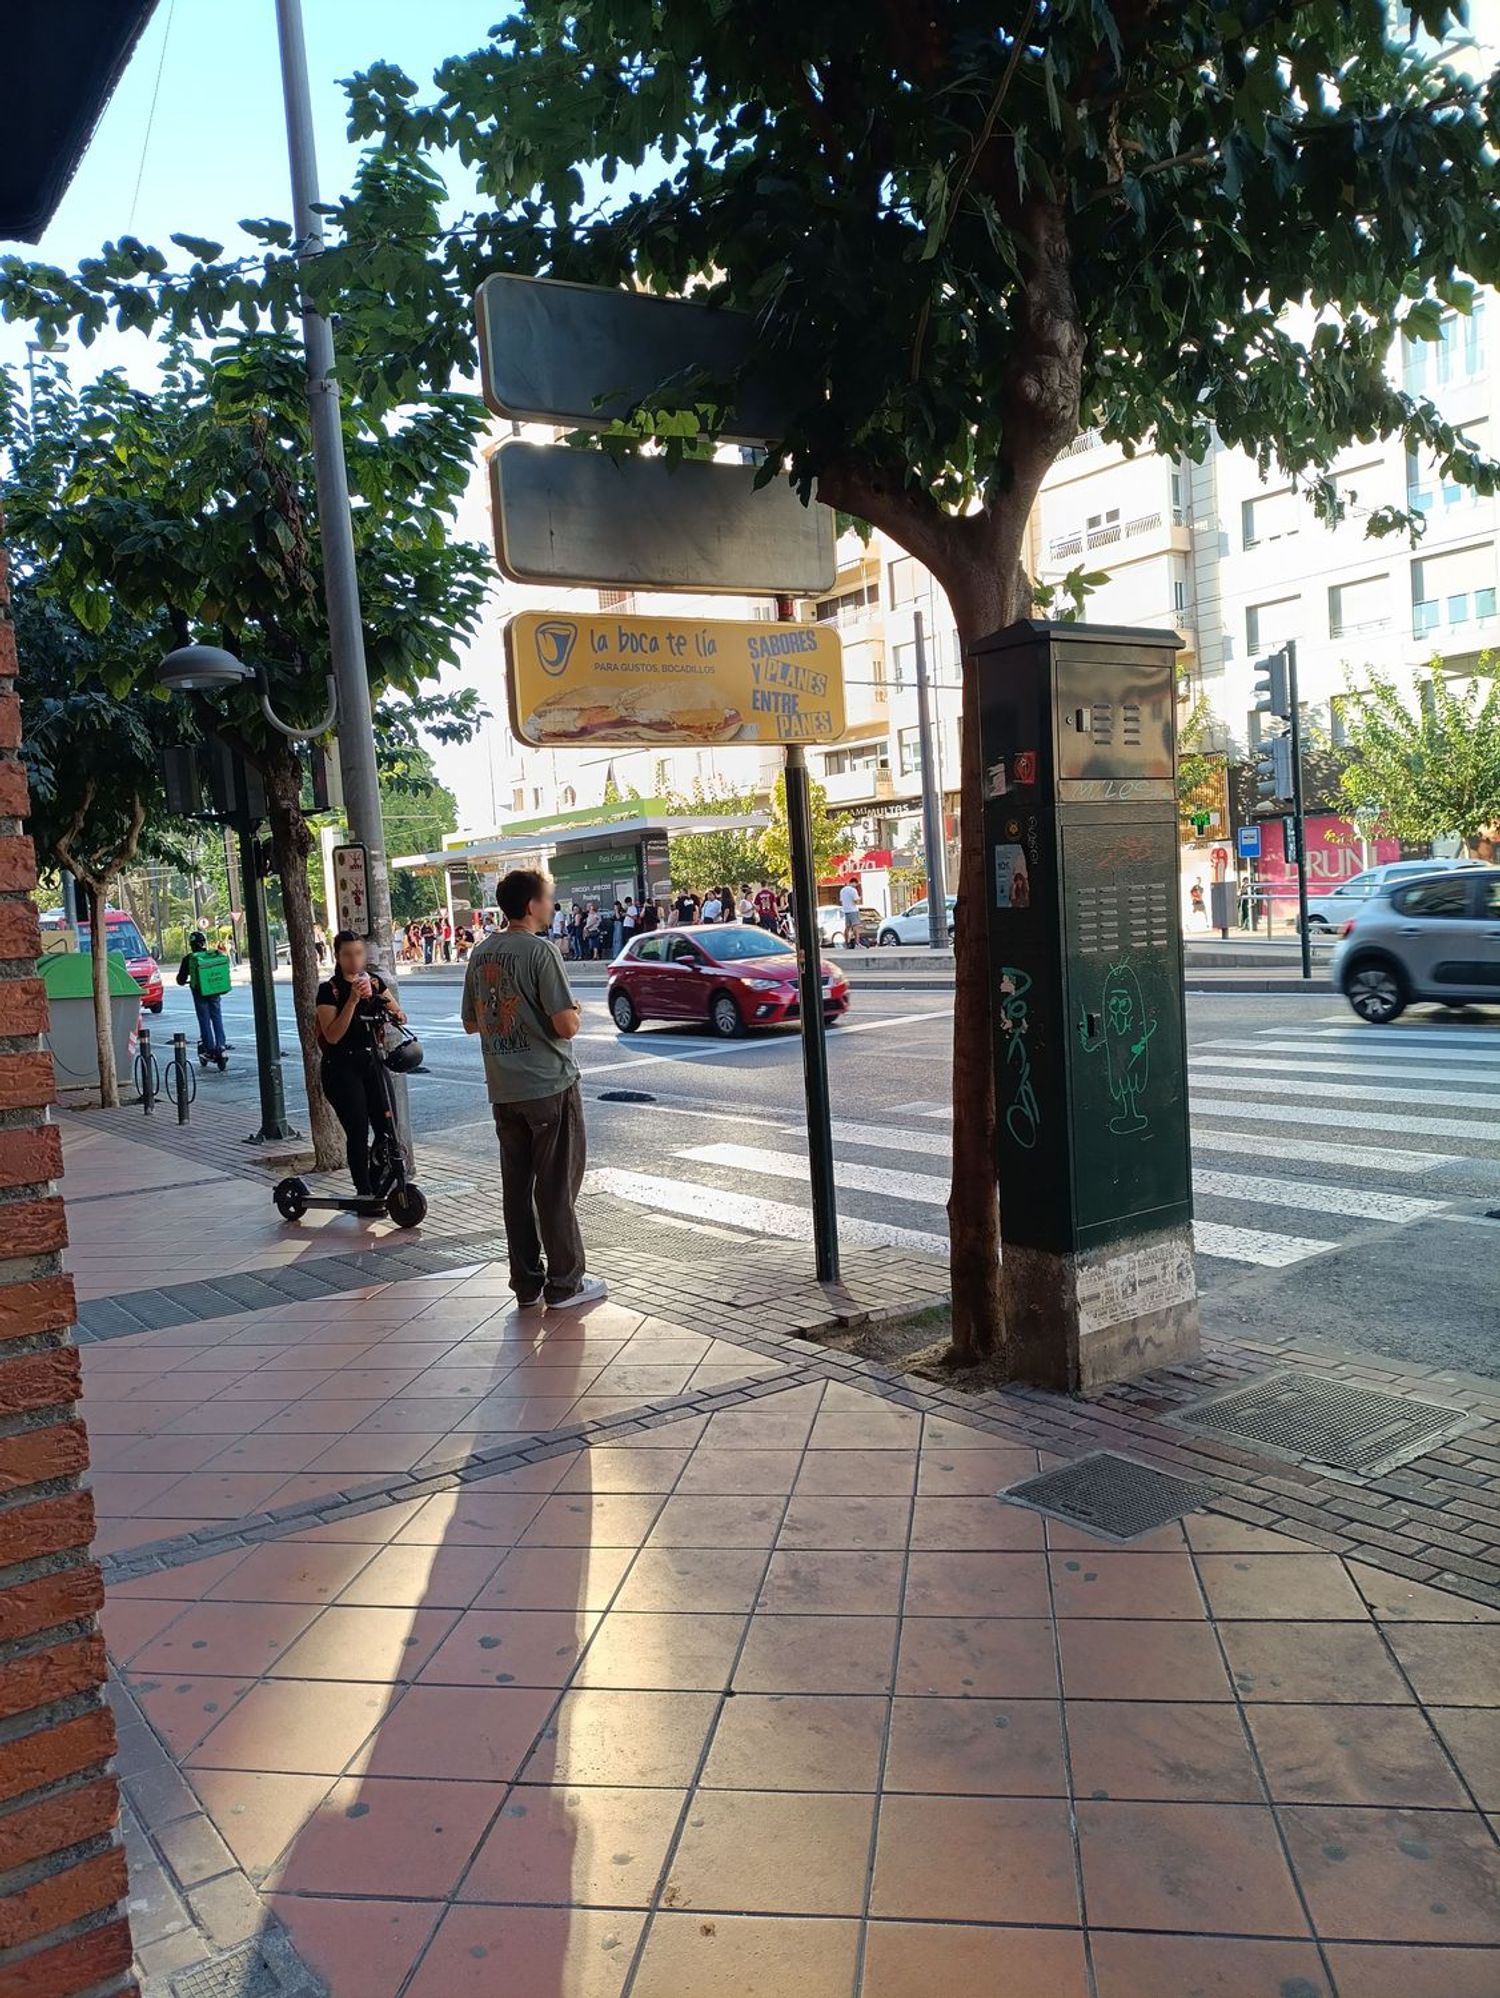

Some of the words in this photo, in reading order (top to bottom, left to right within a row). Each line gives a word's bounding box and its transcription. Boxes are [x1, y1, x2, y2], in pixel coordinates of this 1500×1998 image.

[590, 628, 608, 654] la
[618, 625, 659, 653] boca
[665, 632, 687, 656] te
[748, 629, 818, 659] SABORES
[594, 662, 619, 672] PARA
[661, 664, 715, 674] BOCADILLOS
[751, 662, 761, 684] Y
[766, 658, 827, 697] PLANES
[752, 689, 800, 715] ENTRE
[778, 712, 832, 738] PANES
